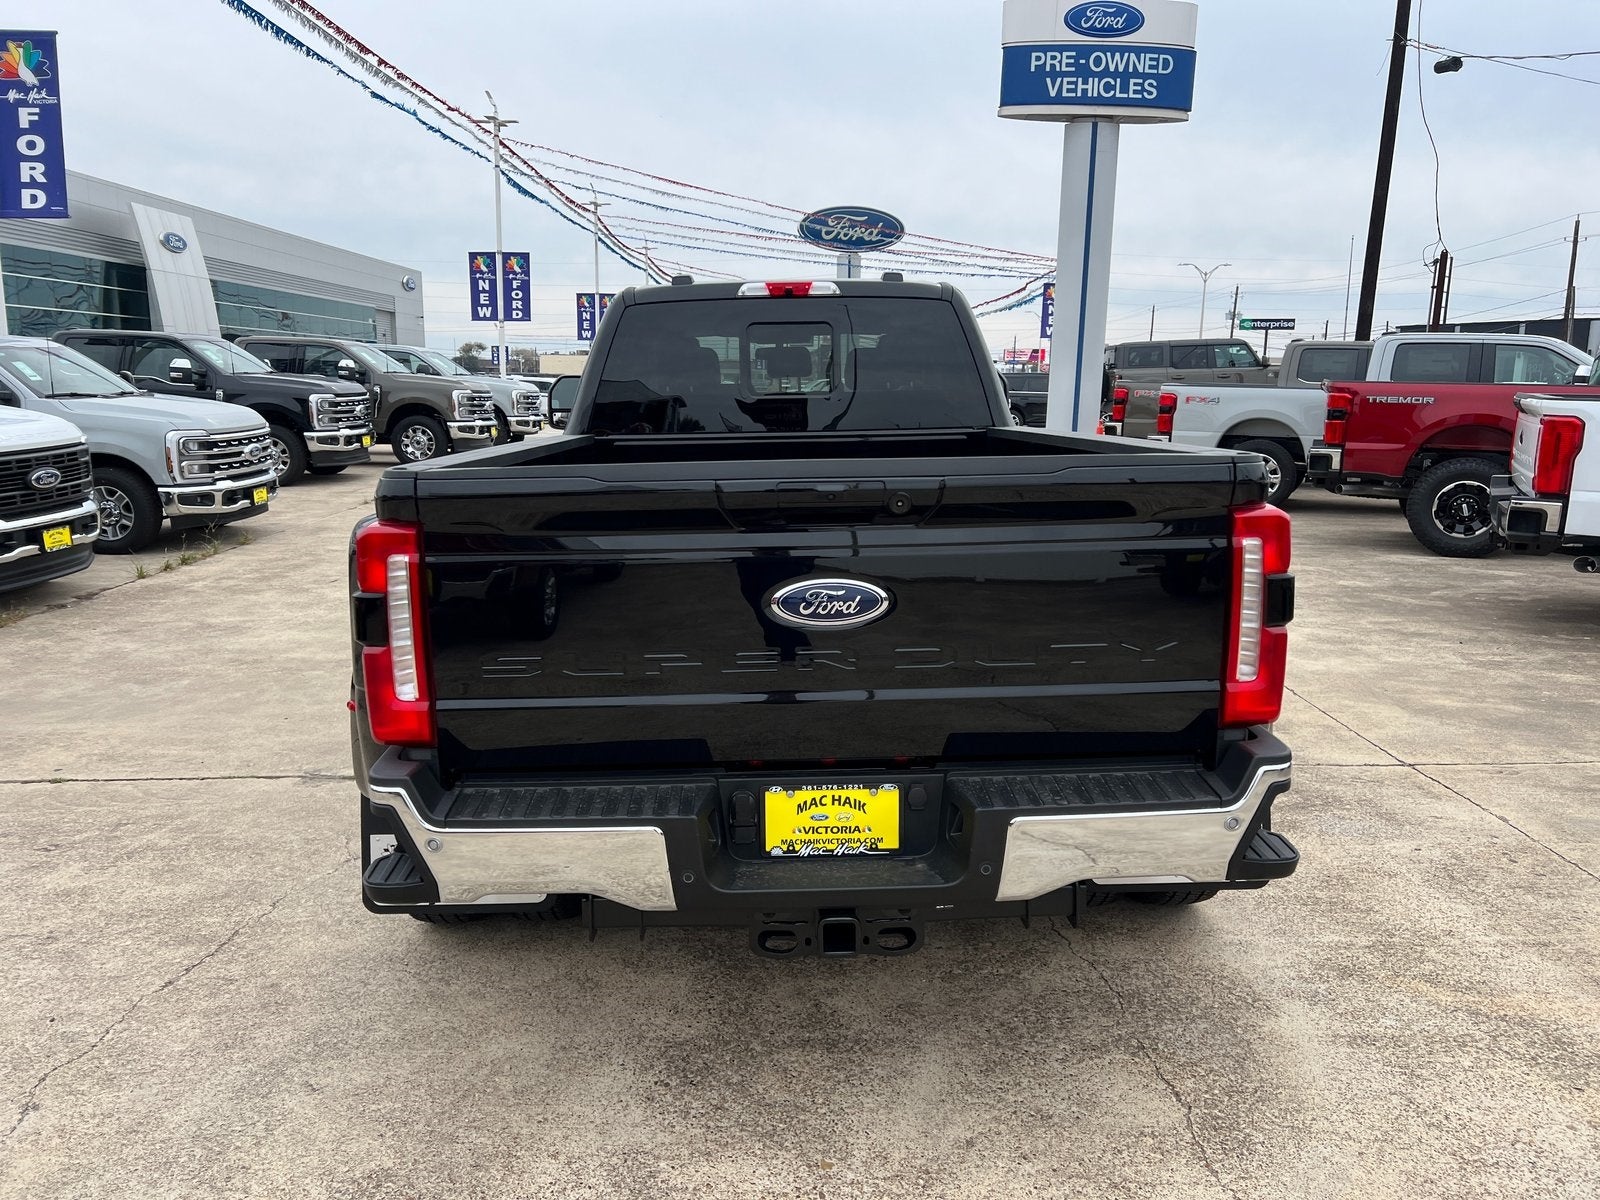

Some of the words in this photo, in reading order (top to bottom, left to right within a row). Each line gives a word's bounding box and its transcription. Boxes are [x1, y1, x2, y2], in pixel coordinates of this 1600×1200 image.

[1081, 6, 1127, 29] Ford
[8, 88, 27, 104] Mac
[1046, 77, 1158, 99] VEHICLES
[16, 107, 48, 209] FORD
[821, 214, 884, 241] Ford
[477, 280, 492, 318] NEW
[511, 280, 523, 319] FORD
[582, 311, 592, 339] NEW
[1241, 320, 1294, 329] enterprise
[1185, 396, 1220, 404] FX4
[1366, 395, 1435, 404] TREMOR
[40, 473, 55, 484] Ford
[800, 589, 861, 615] Ford
[796, 795, 828, 815] MAC
[831, 795, 867, 814] HAIK
[803, 825, 862, 834] VICTORIA
[798, 843, 832, 857] Mac
[833, 842, 873, 856] Haik
